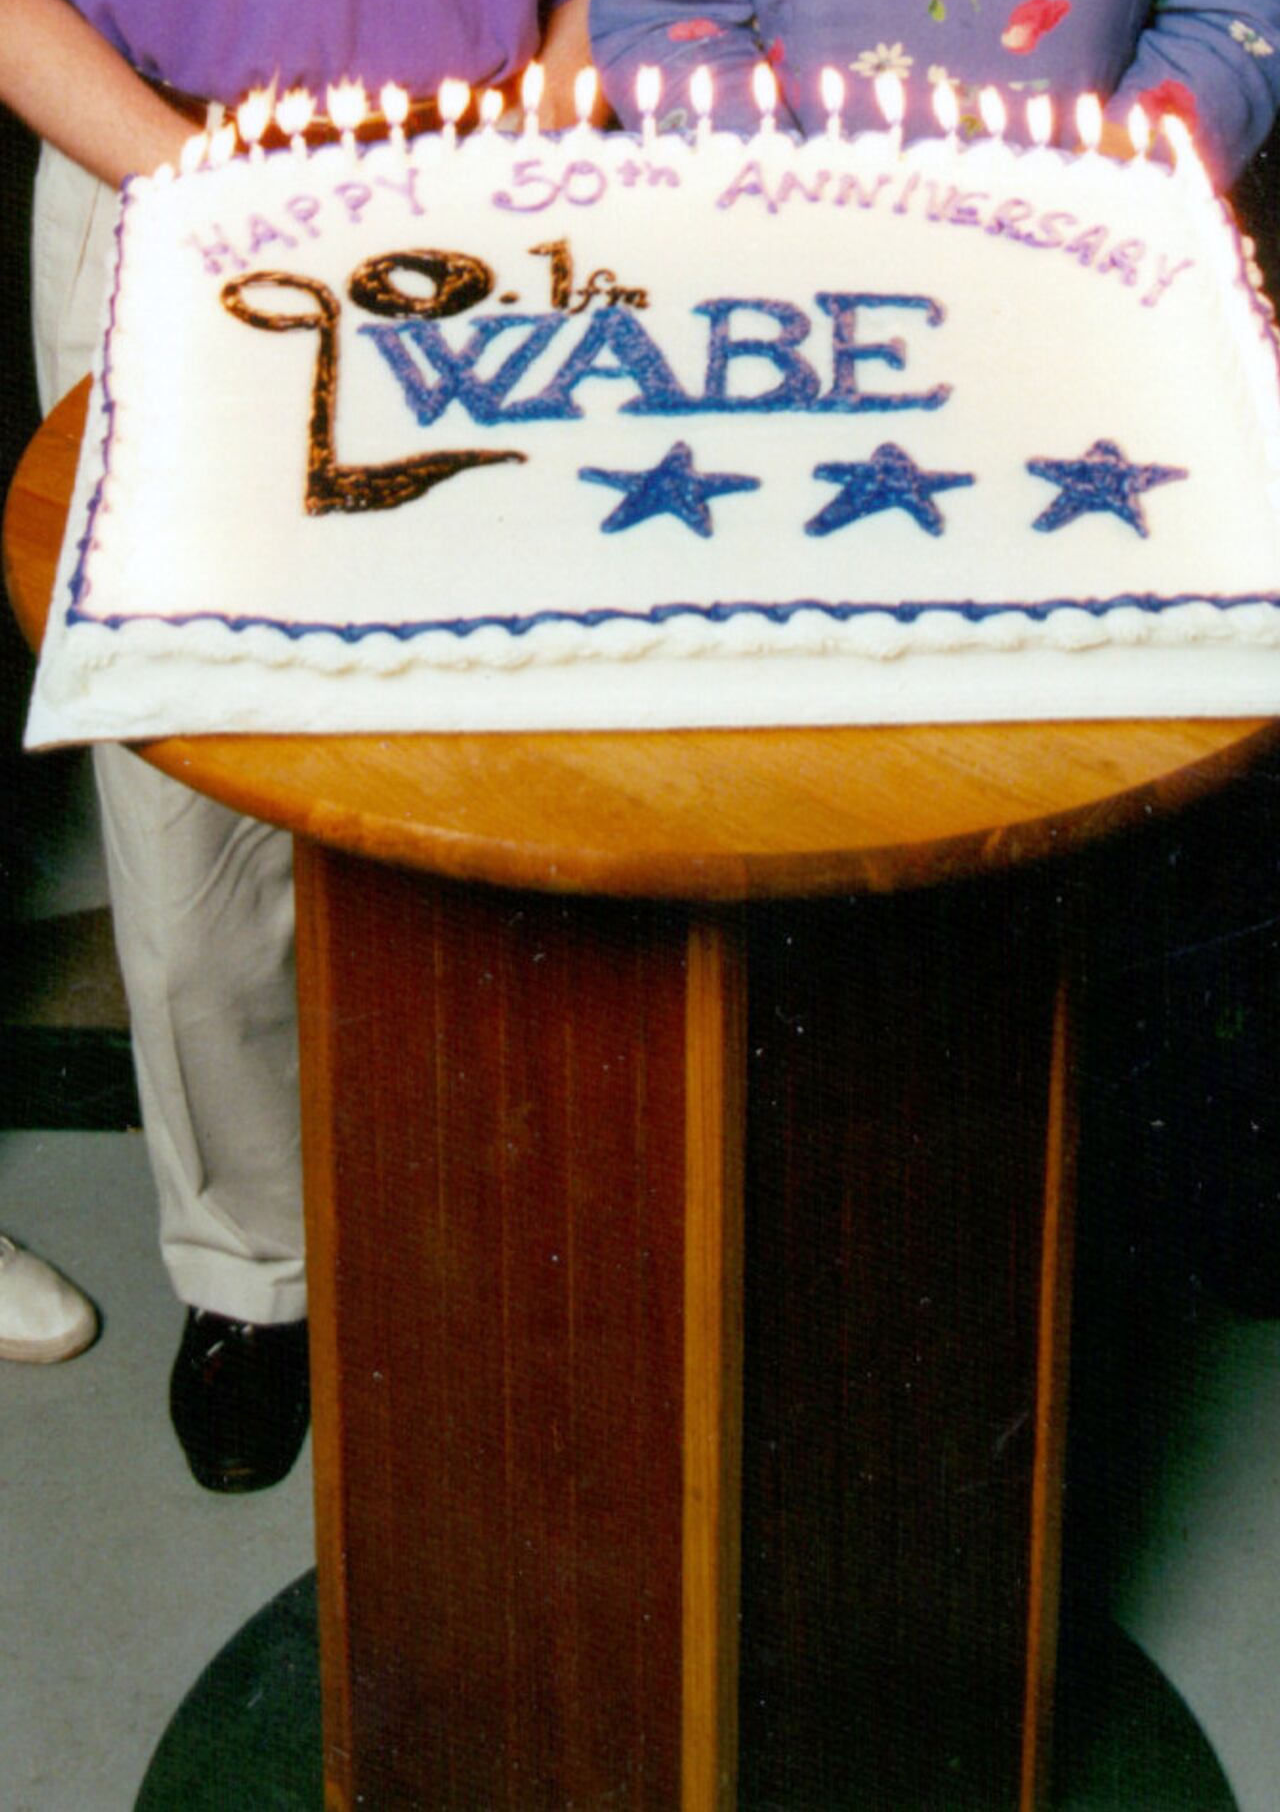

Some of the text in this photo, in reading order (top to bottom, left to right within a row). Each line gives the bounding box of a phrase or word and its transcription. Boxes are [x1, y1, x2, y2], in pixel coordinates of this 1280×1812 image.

[189, 159, 1196, 306] HAPPY 50th ANNIVERSARY
[356, 291, 953, 428] WABE
